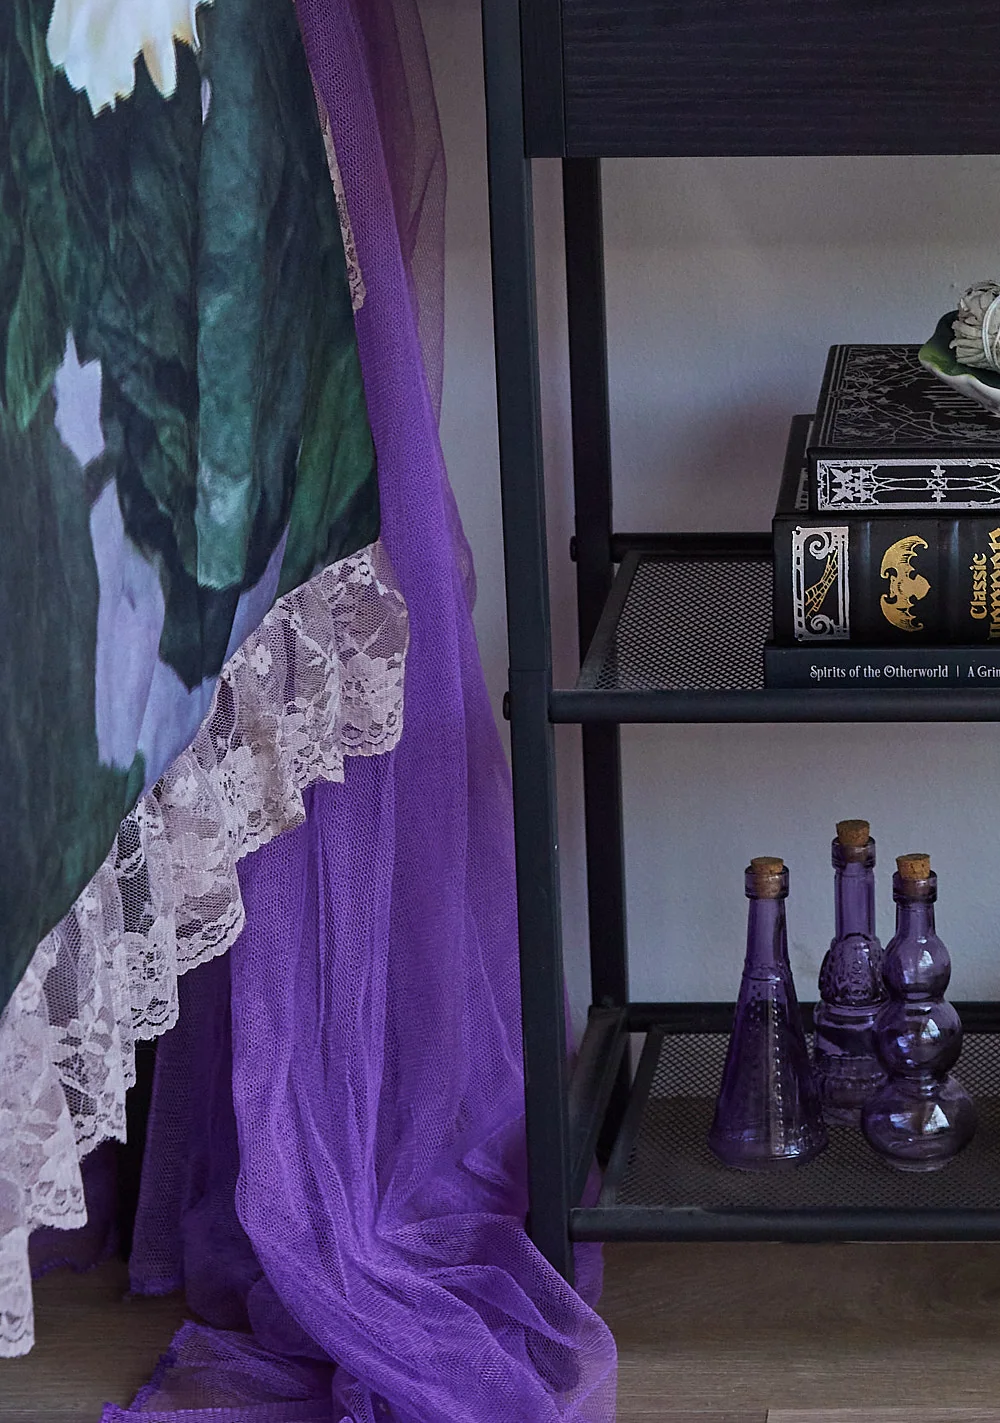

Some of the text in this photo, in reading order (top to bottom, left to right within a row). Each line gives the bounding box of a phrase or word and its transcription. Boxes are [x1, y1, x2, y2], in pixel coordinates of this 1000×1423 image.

[969, 552, 988, 620] Classic
[809, 664, 949, 681] Spirits of the Otherworld
[967, 665, 975, 678] A
